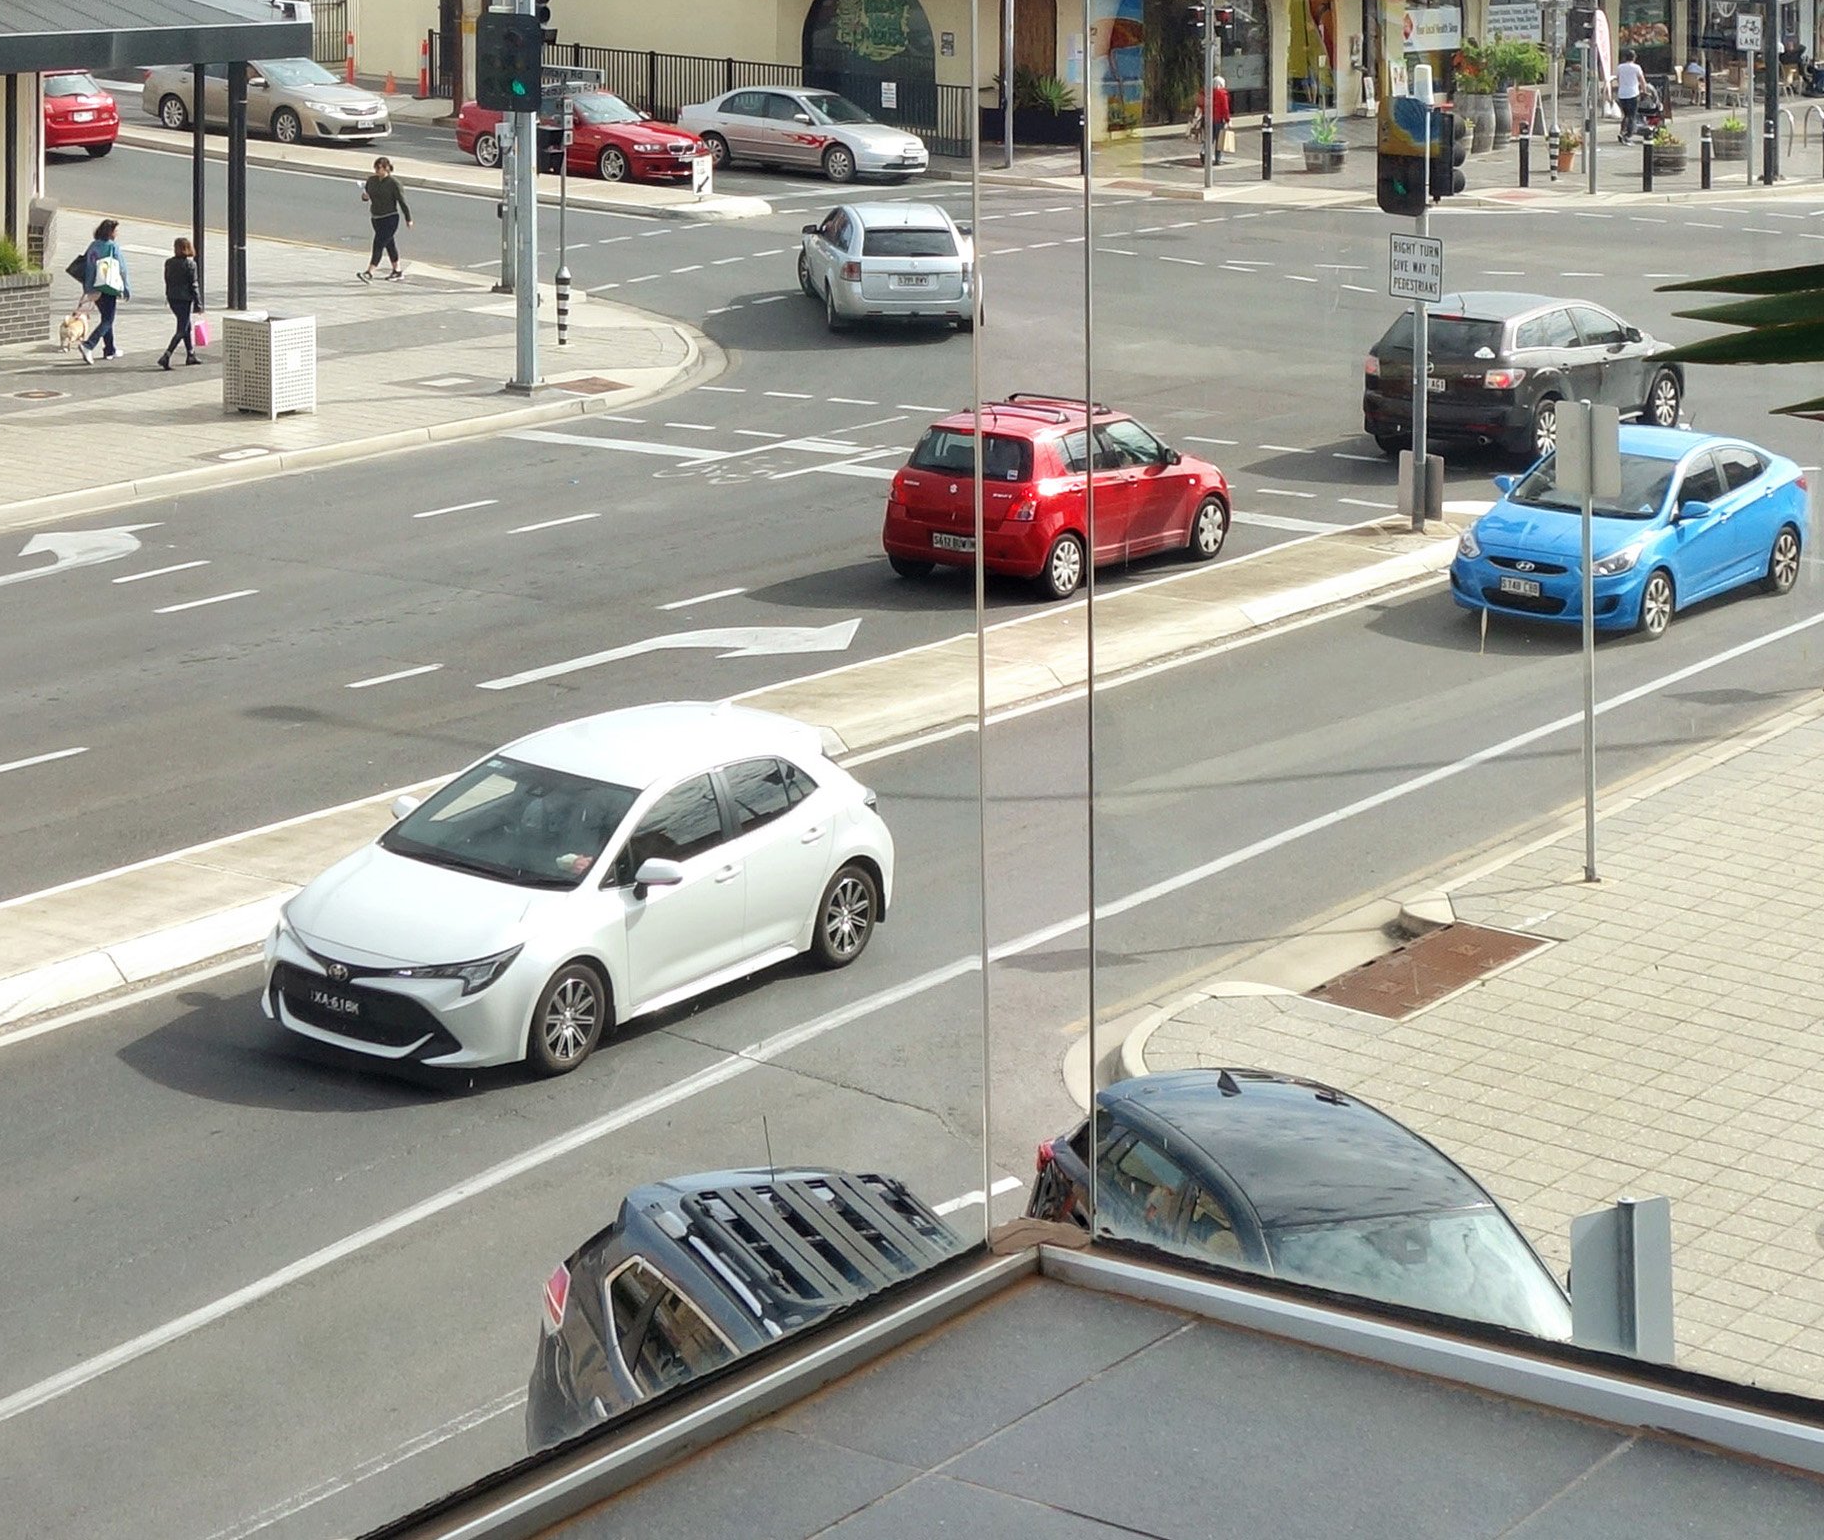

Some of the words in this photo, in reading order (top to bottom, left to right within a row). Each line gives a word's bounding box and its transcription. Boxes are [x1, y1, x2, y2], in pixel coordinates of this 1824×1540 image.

[1739, 37, 1761, 47] LANE
[571, 70, 583, 79] Rd
[1393, 241, 1416, 255] RIGHT
[1420, 244, 1439, 258] TURN
[1393, 259, 1408, 273] GIVE
[1413, 262, 1426, 274] WAY
[1431, 264, 1439, 276] TO
[1393, 277, 1438, 295] PEDESTRIANS
